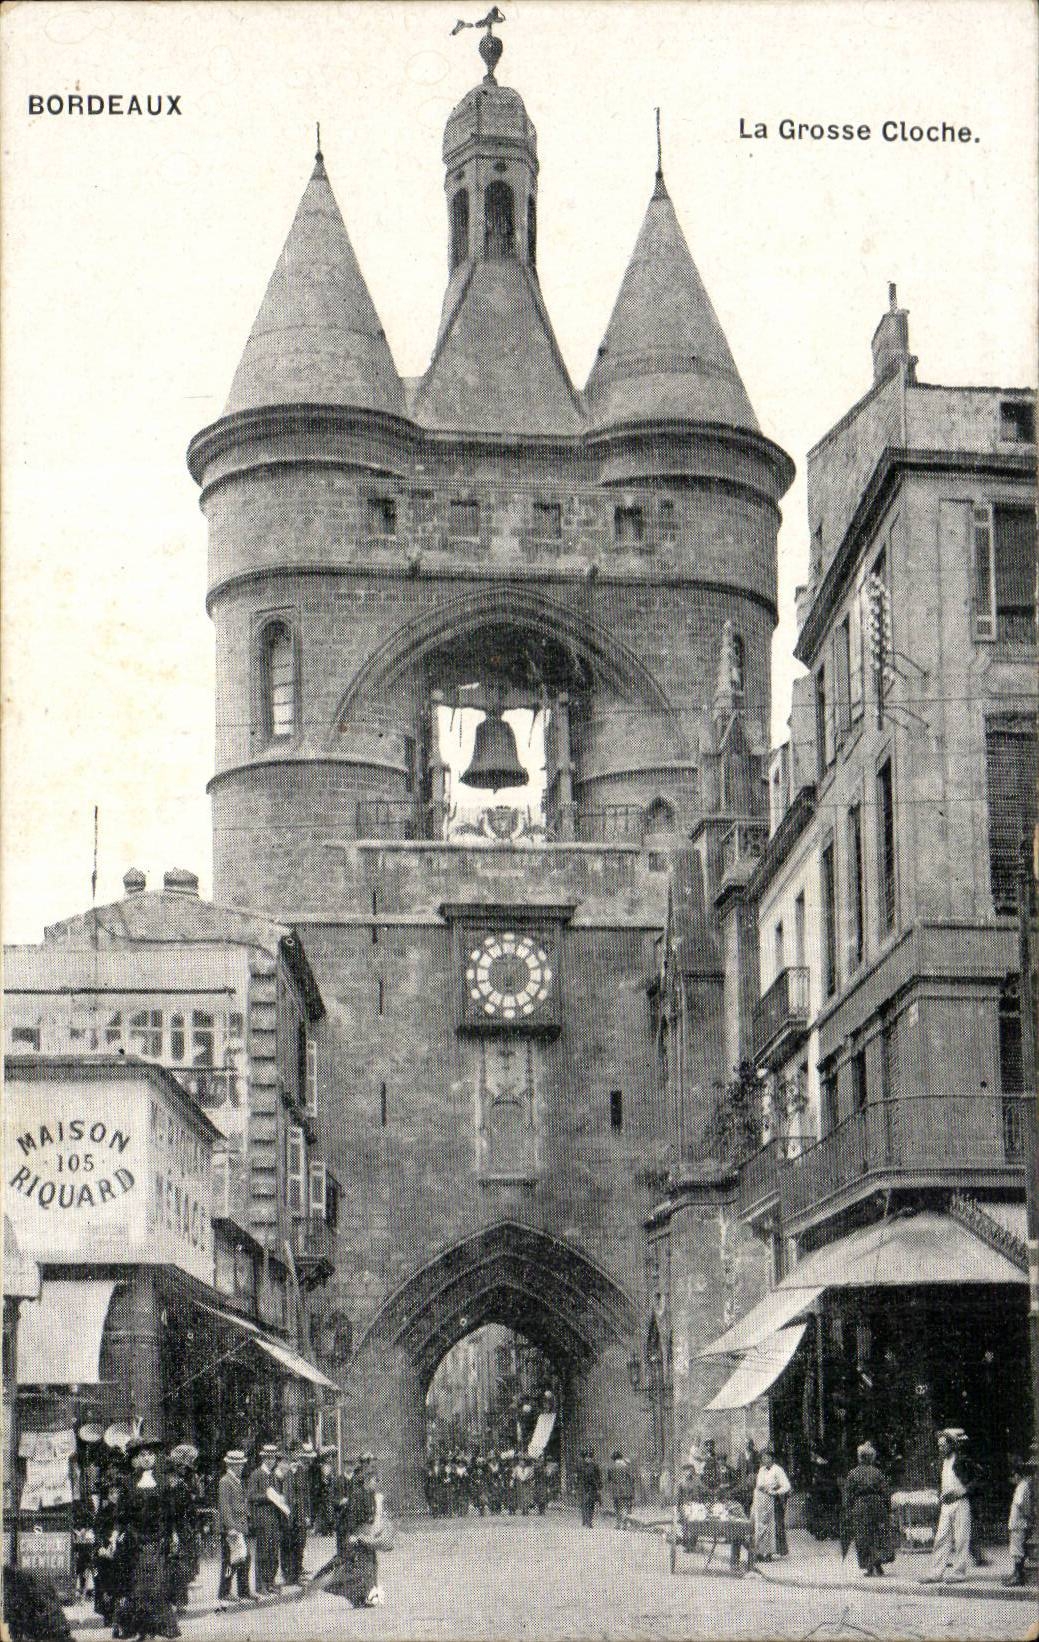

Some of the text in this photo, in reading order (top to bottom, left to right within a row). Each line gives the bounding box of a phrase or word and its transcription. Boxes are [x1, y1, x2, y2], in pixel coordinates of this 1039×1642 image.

[16, 1120, 131, 1156] MAISON
[57, 1153, 95, 1173] 105
[9, 1165, 136, 1210] RIQUARD
